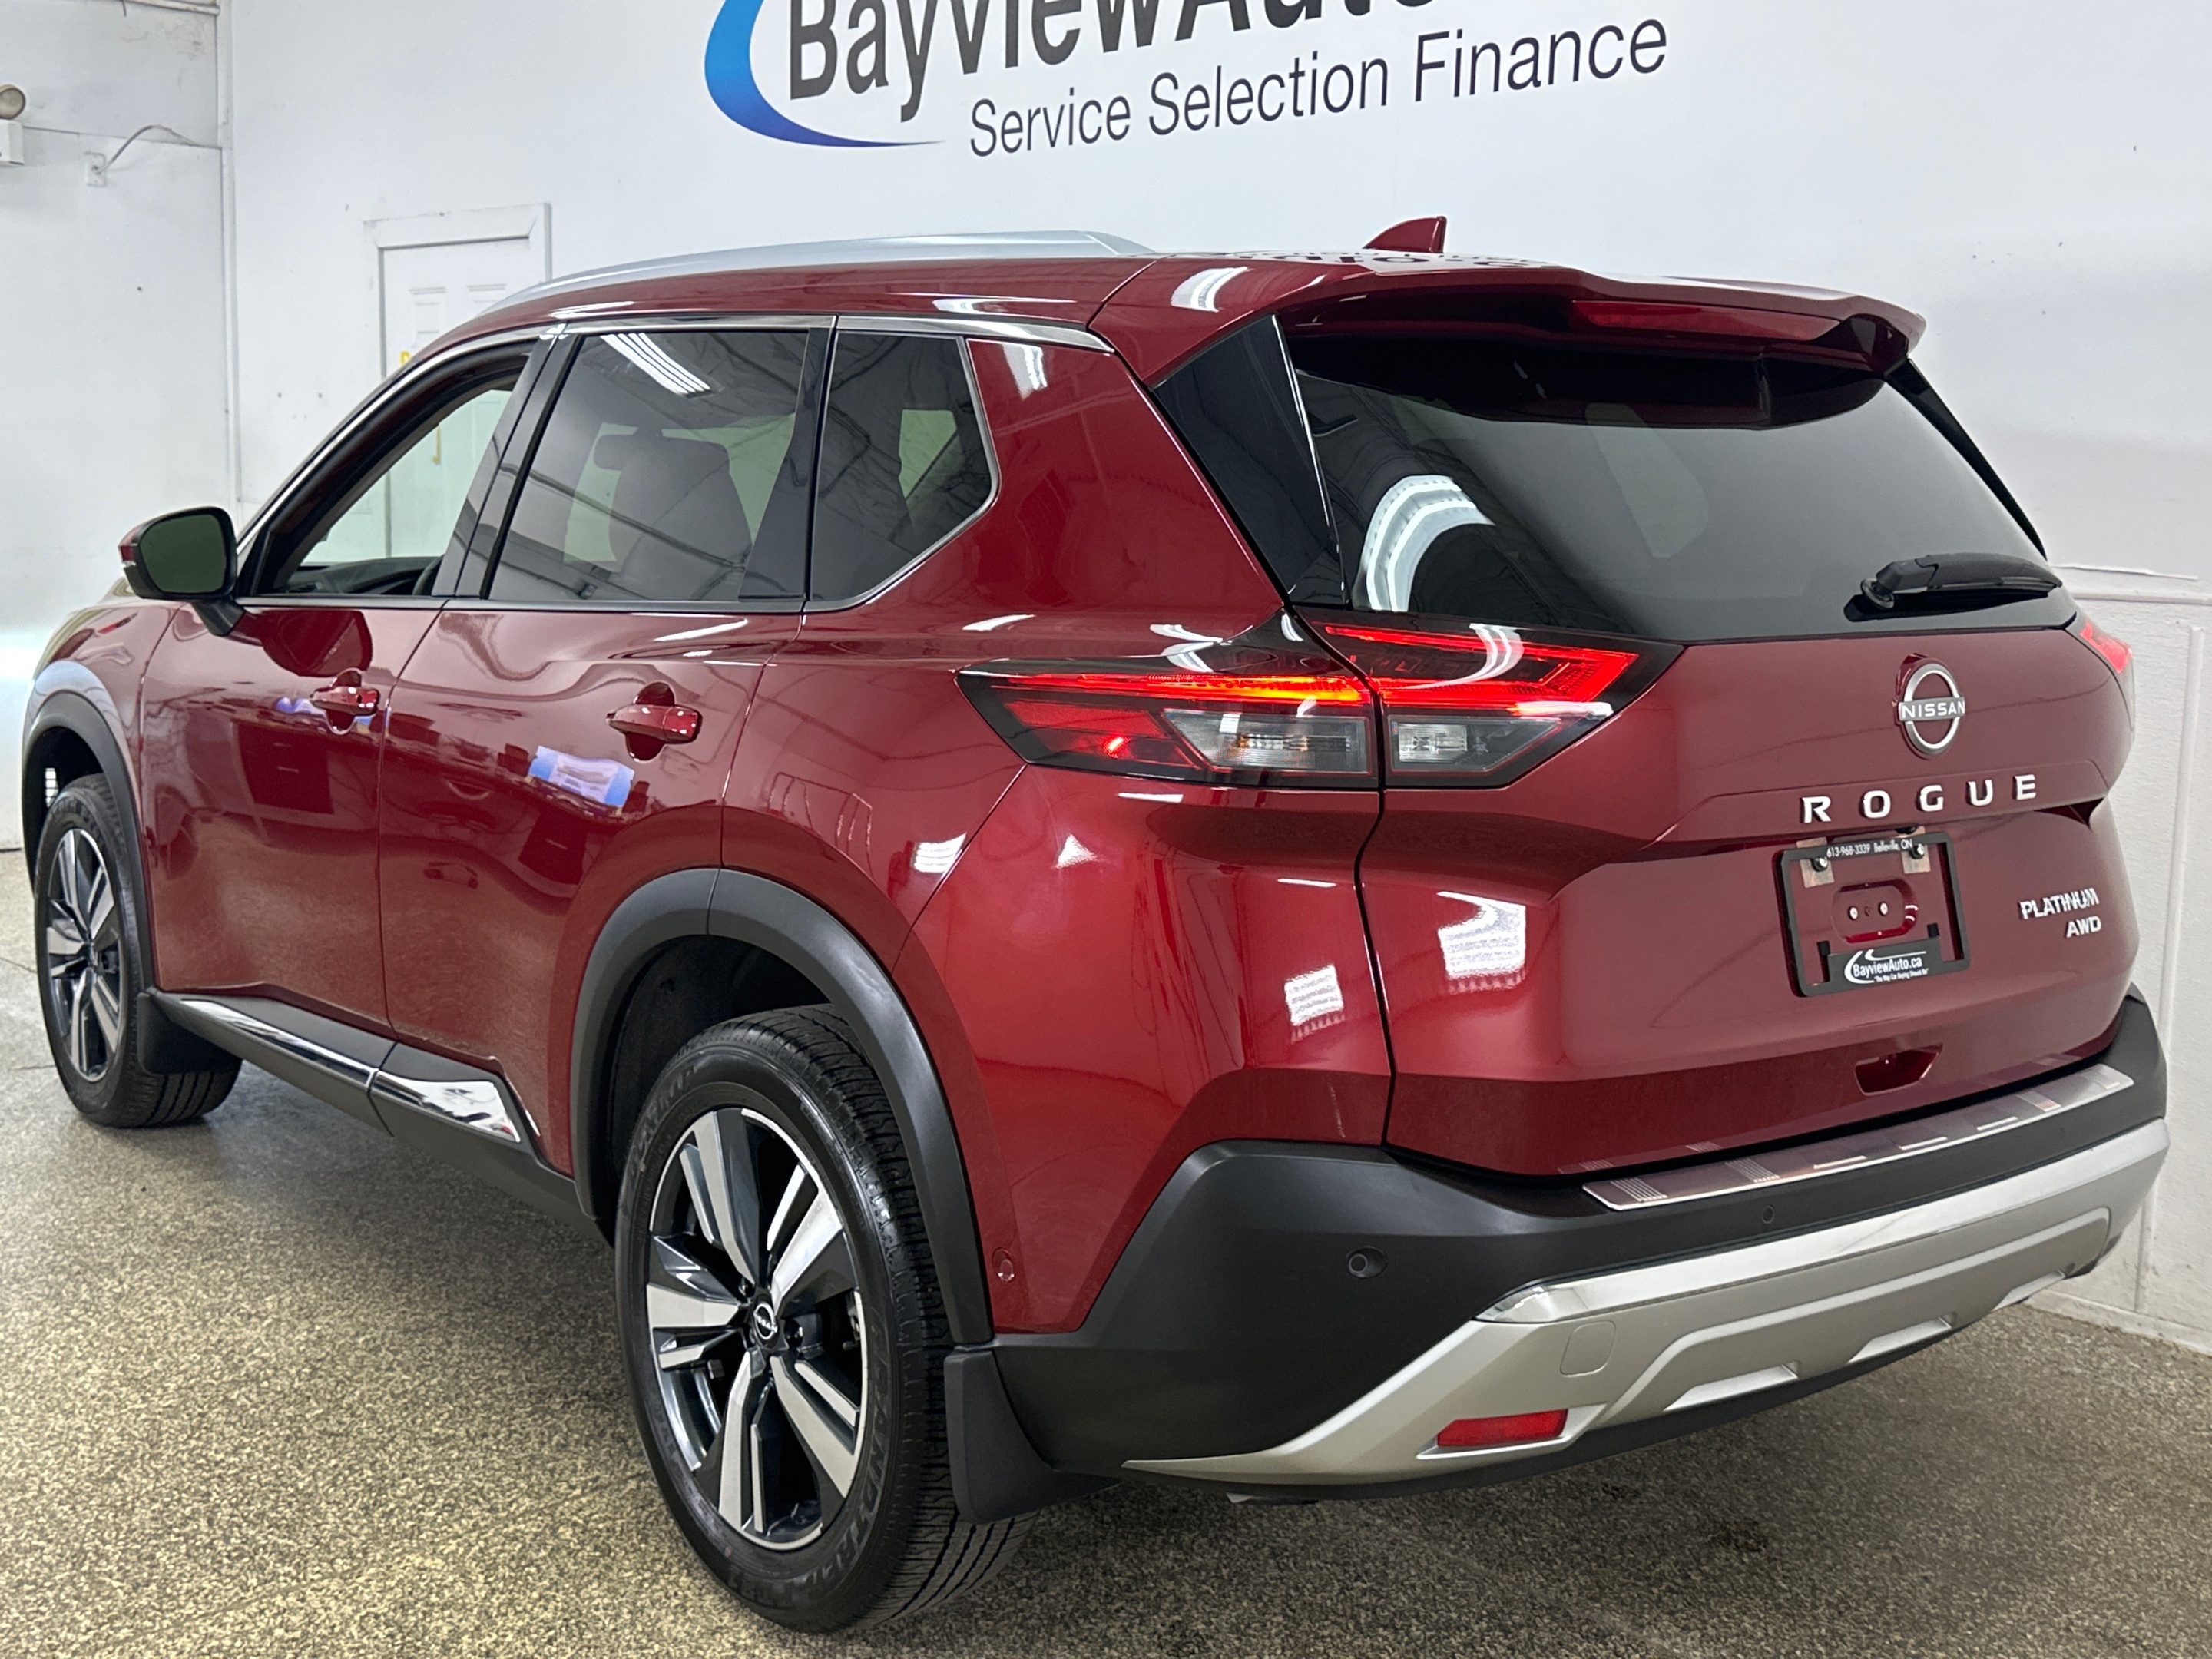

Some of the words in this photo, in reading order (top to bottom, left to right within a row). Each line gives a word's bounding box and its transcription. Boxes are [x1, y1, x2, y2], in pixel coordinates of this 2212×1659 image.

[790, 0, 1435, 123] Bayview
[970, 87, 1131, 157] Service
[1148, 51, 1389, 136] Selection
[1415, 18, 1667, 102] Finance
[1901, 700, 1965, 719] NISSAN
[1800, 774, 2037, 824] ROGUE
[1900, 838, 1913, 849] ON
[2019, 887, 2100, 919] PLATINUM
[2065, 915, 2102, 938] AWD
[1852, 956, 1923, 979] BayviewAuto.ca
